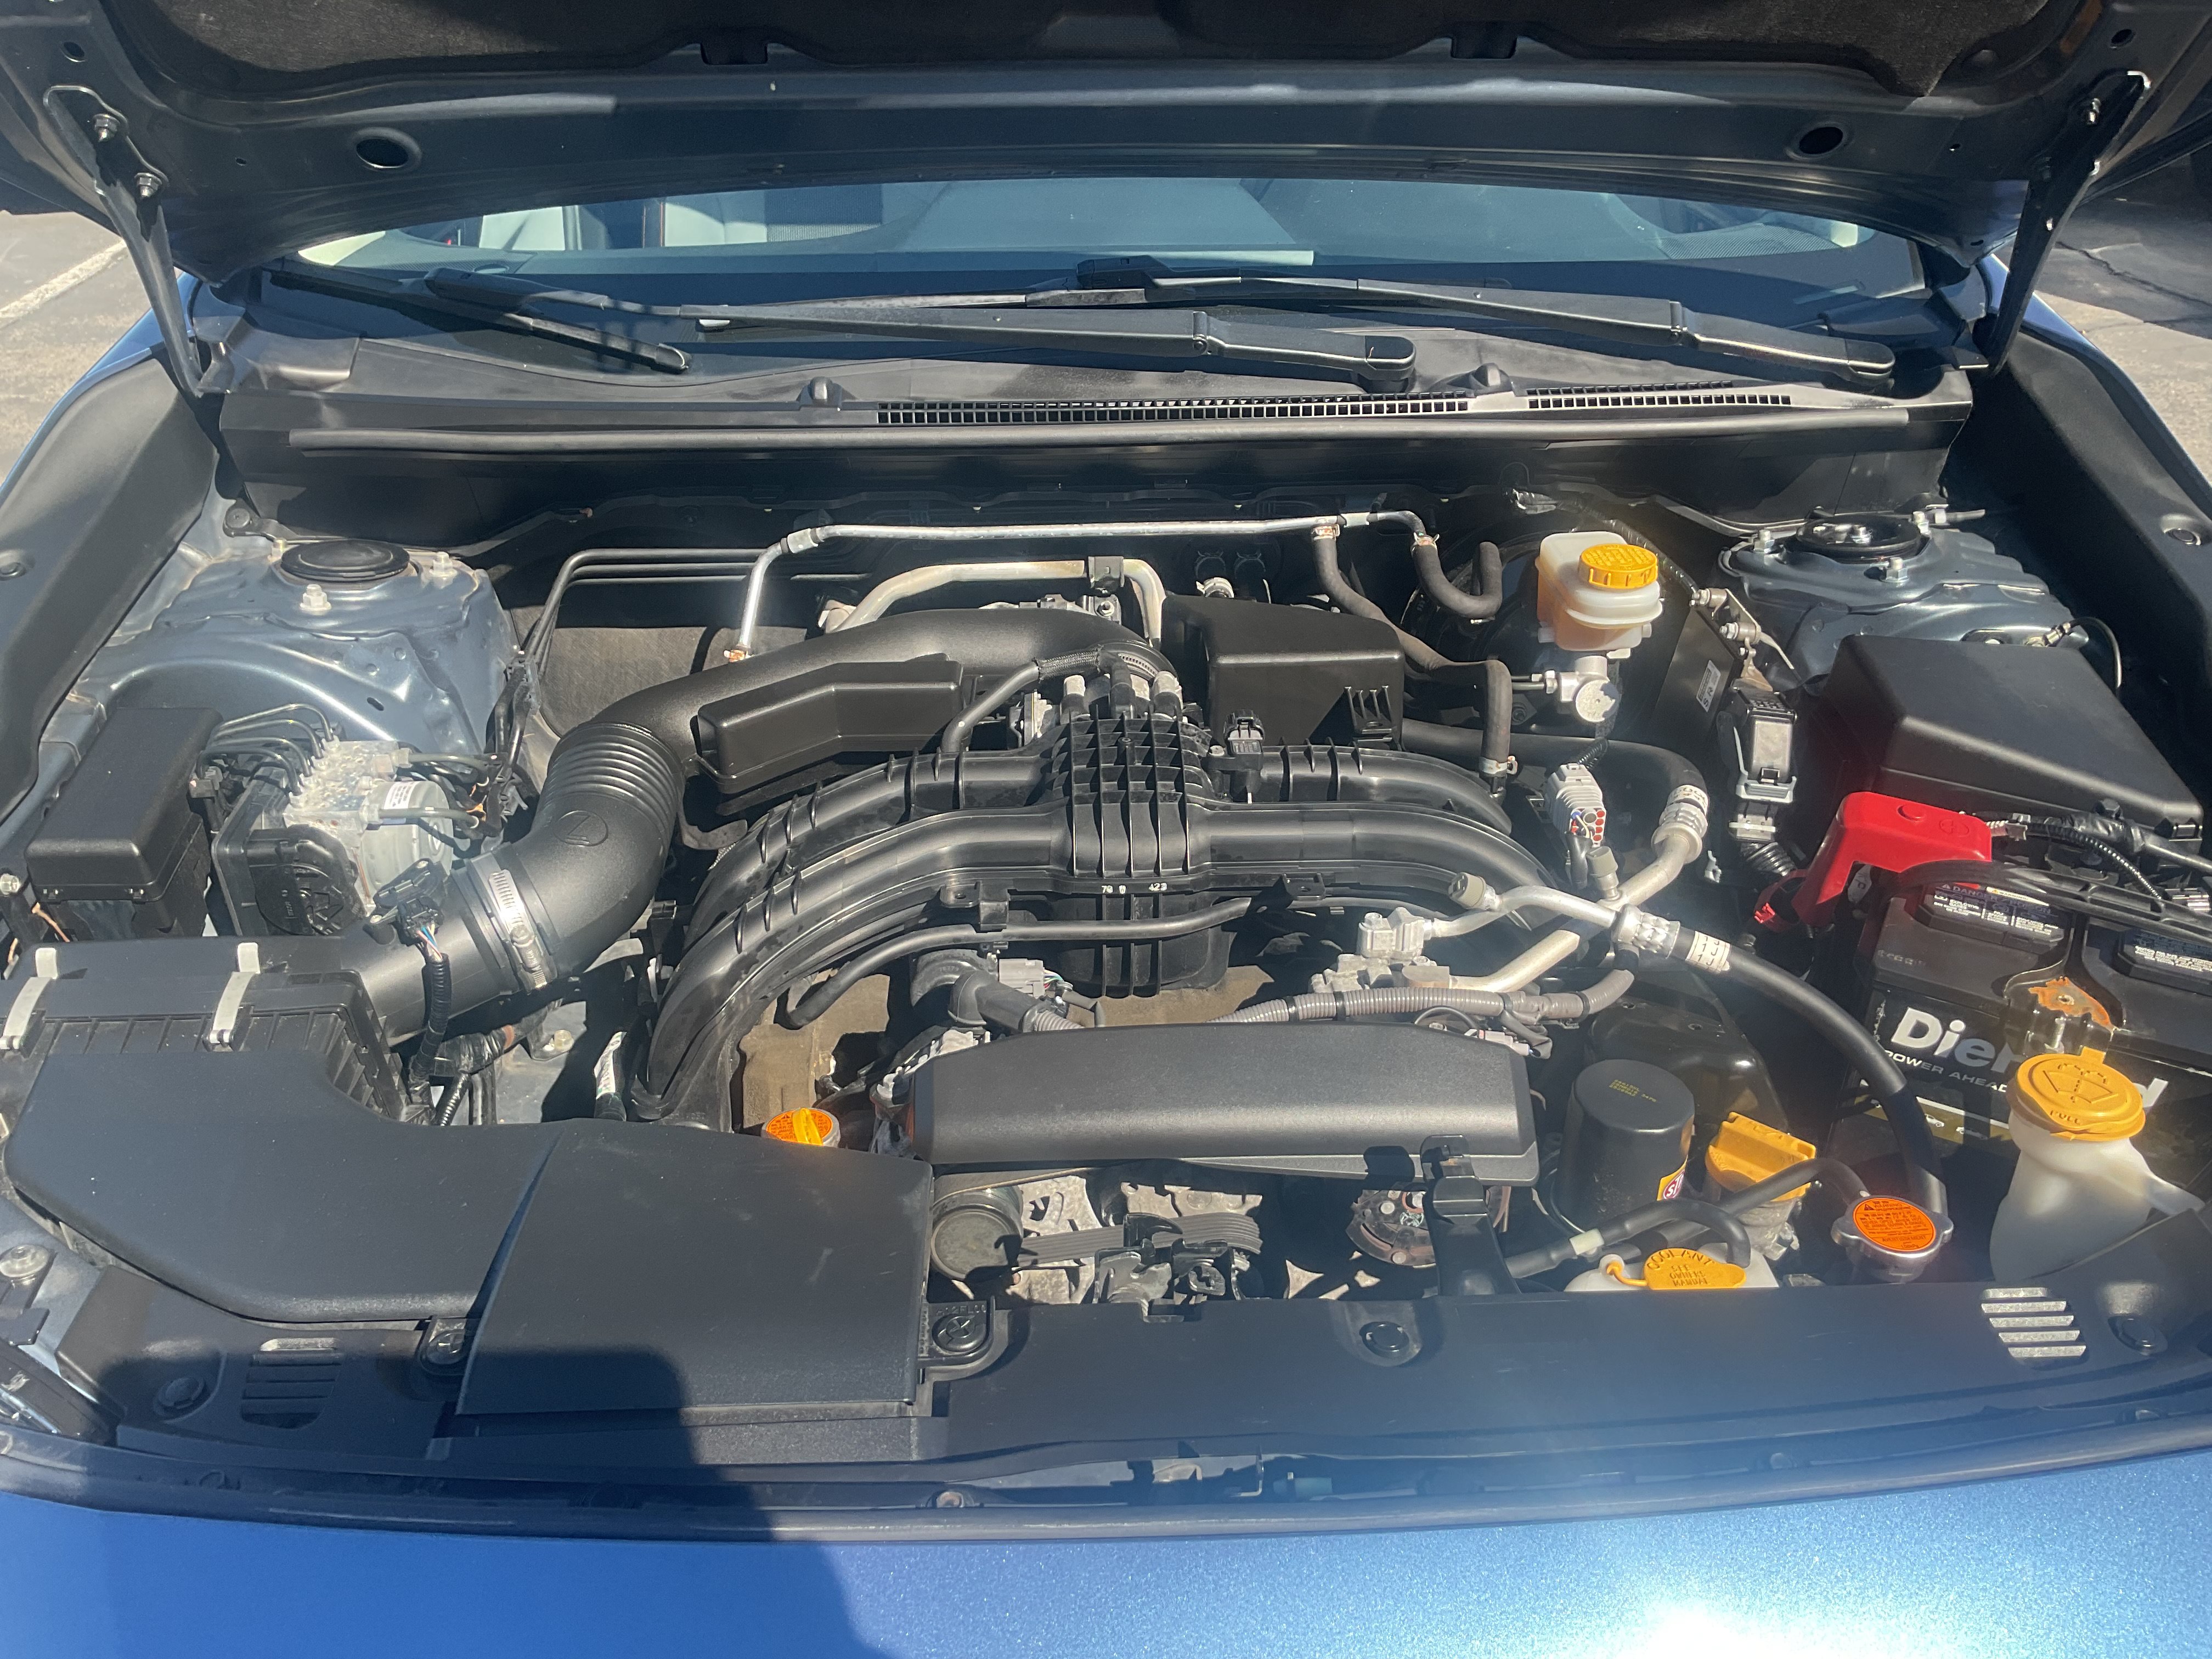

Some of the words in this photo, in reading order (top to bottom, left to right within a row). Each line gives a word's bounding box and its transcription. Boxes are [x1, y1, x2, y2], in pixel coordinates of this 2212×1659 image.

[1953, 886, 1997, 901] DANGER
[2050, 1109, 2081, 1125] PULL
[1646, 1249, 1715, 1271] COOLANT
